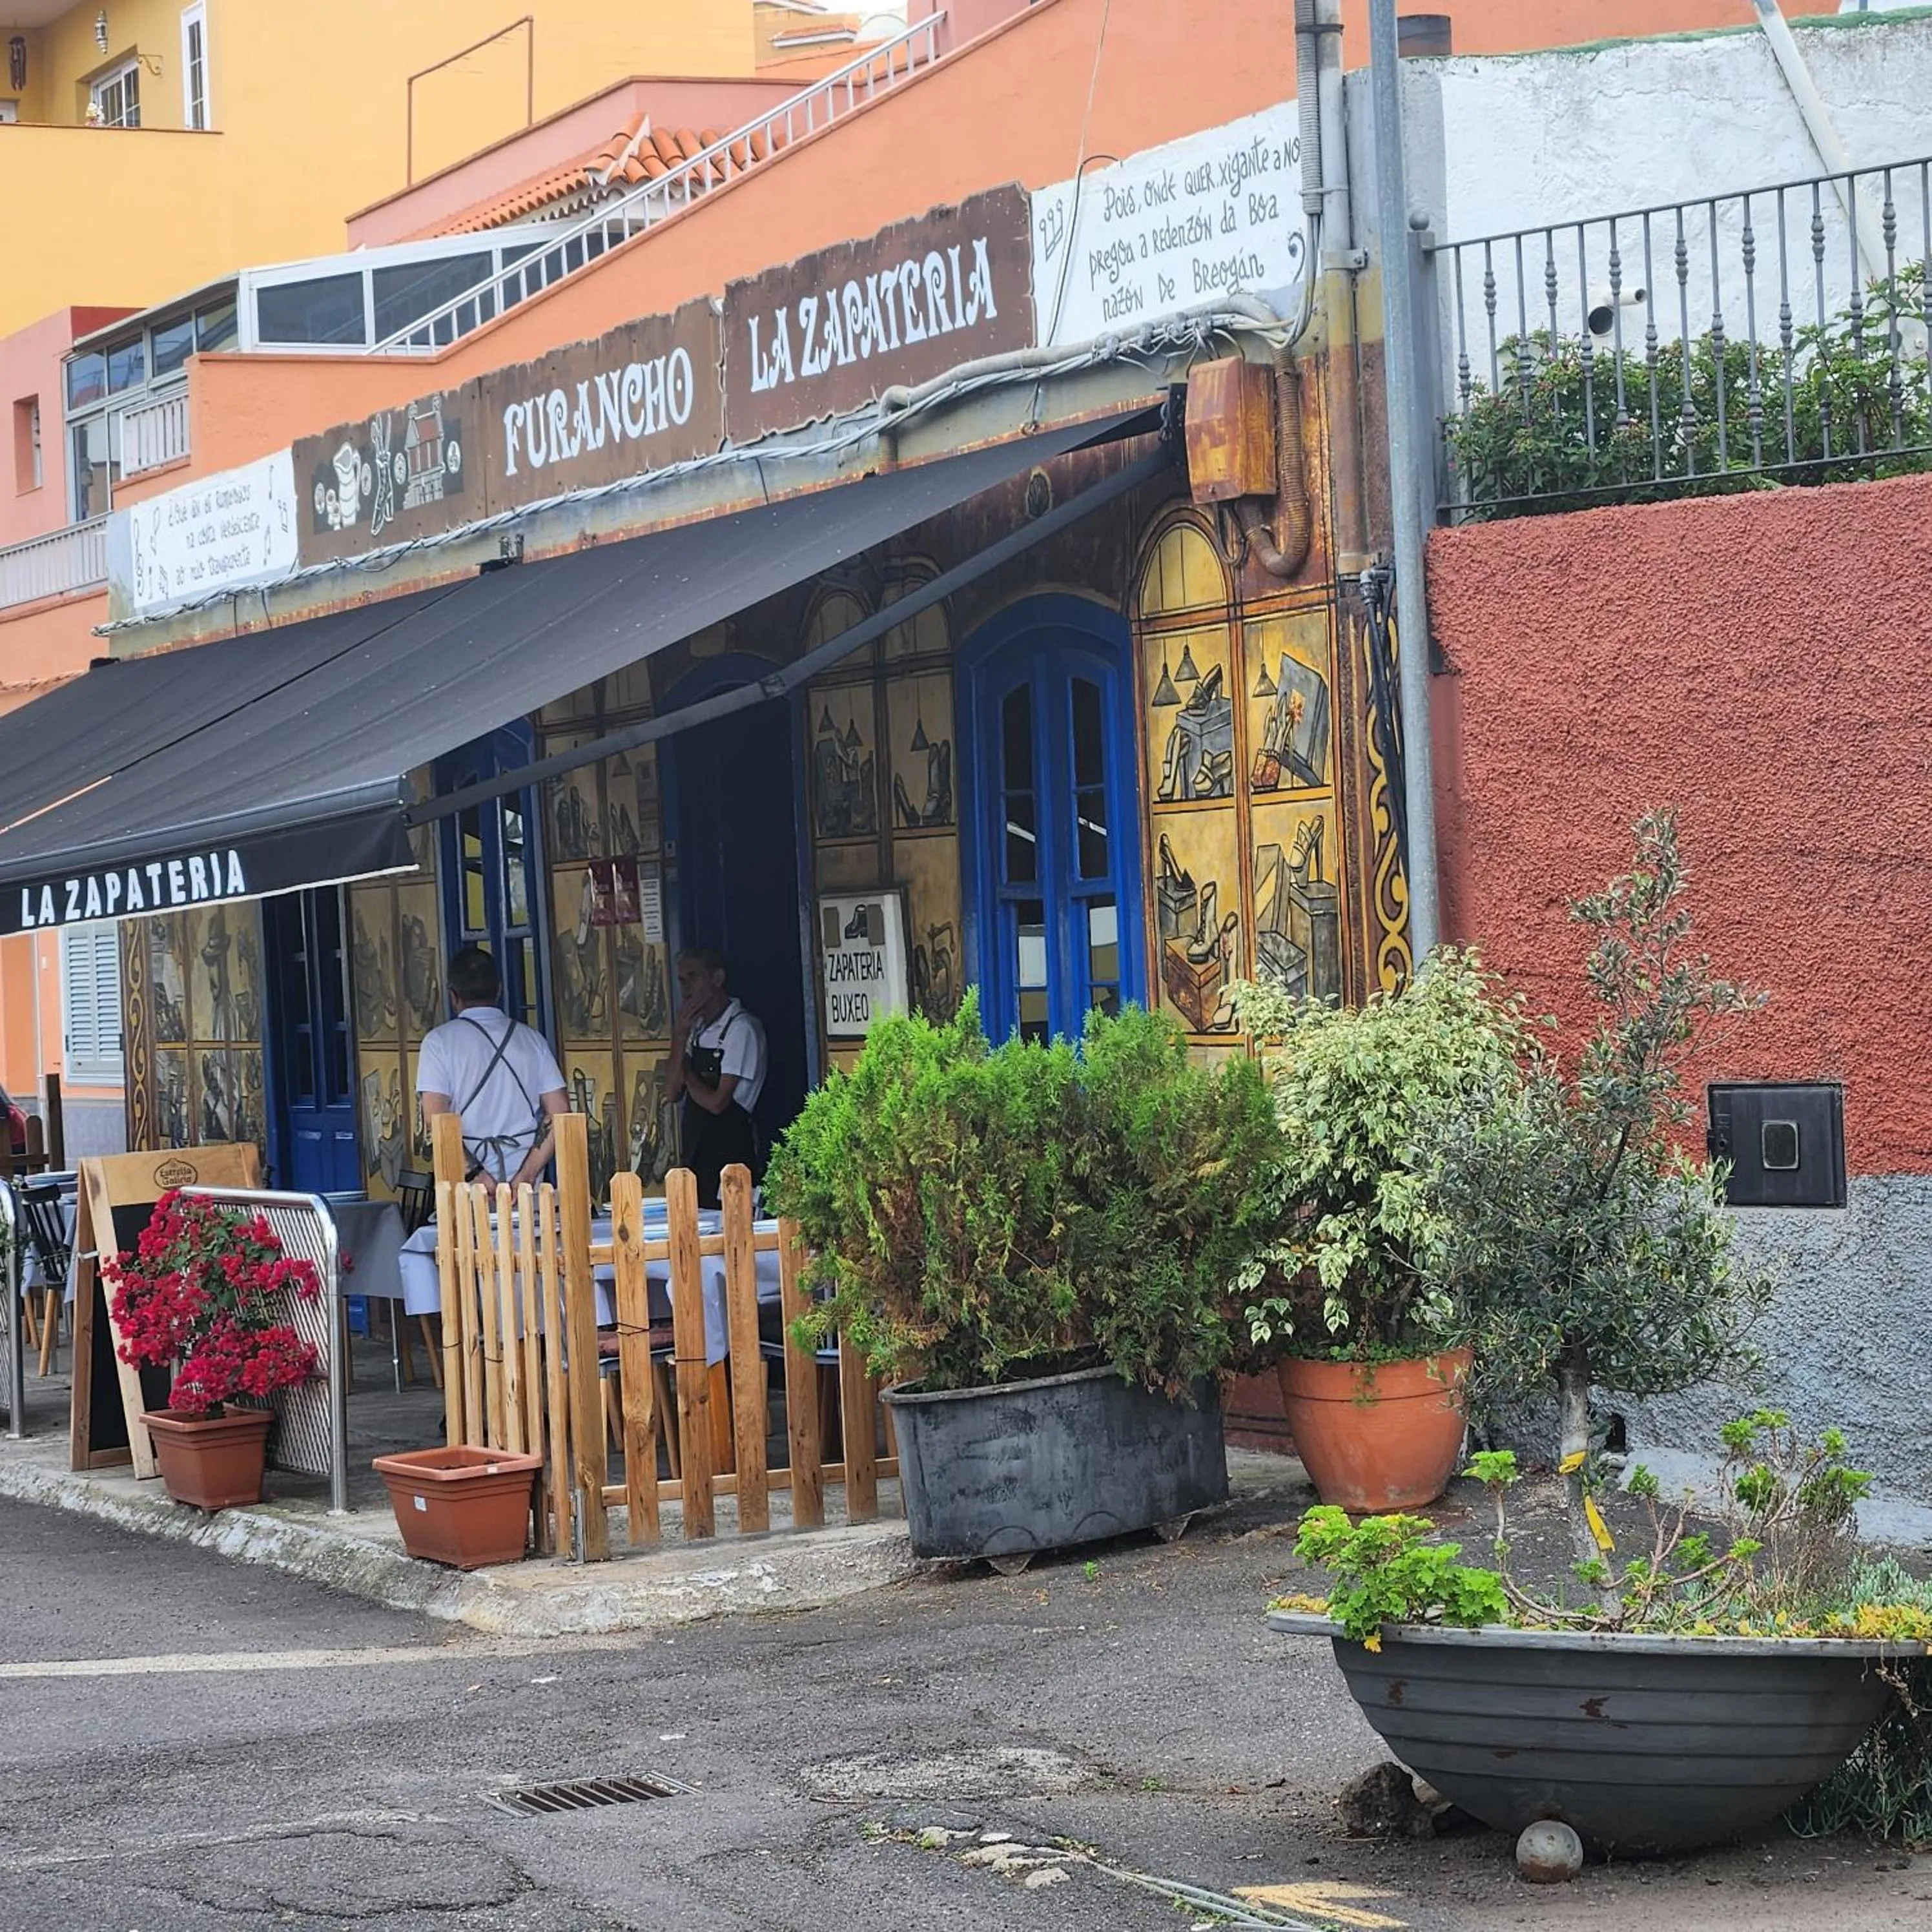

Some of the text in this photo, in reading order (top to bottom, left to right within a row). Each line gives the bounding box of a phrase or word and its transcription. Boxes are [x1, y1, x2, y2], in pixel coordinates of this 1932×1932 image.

[1273, 149, 1282, 170] a
[1138, 232, 1148, 258] a
[1220, 199, 1237, 234] da
[748, 236, 998, 393] LA ZAPATERIA
[503, 347, 694, 477] FURANCHO
[21, 849, 246, 927] LA ZAPATERIA
[828, 951, 885, 981] ZAPATERIA
[831, 994, 868, 1023] BUXEO
